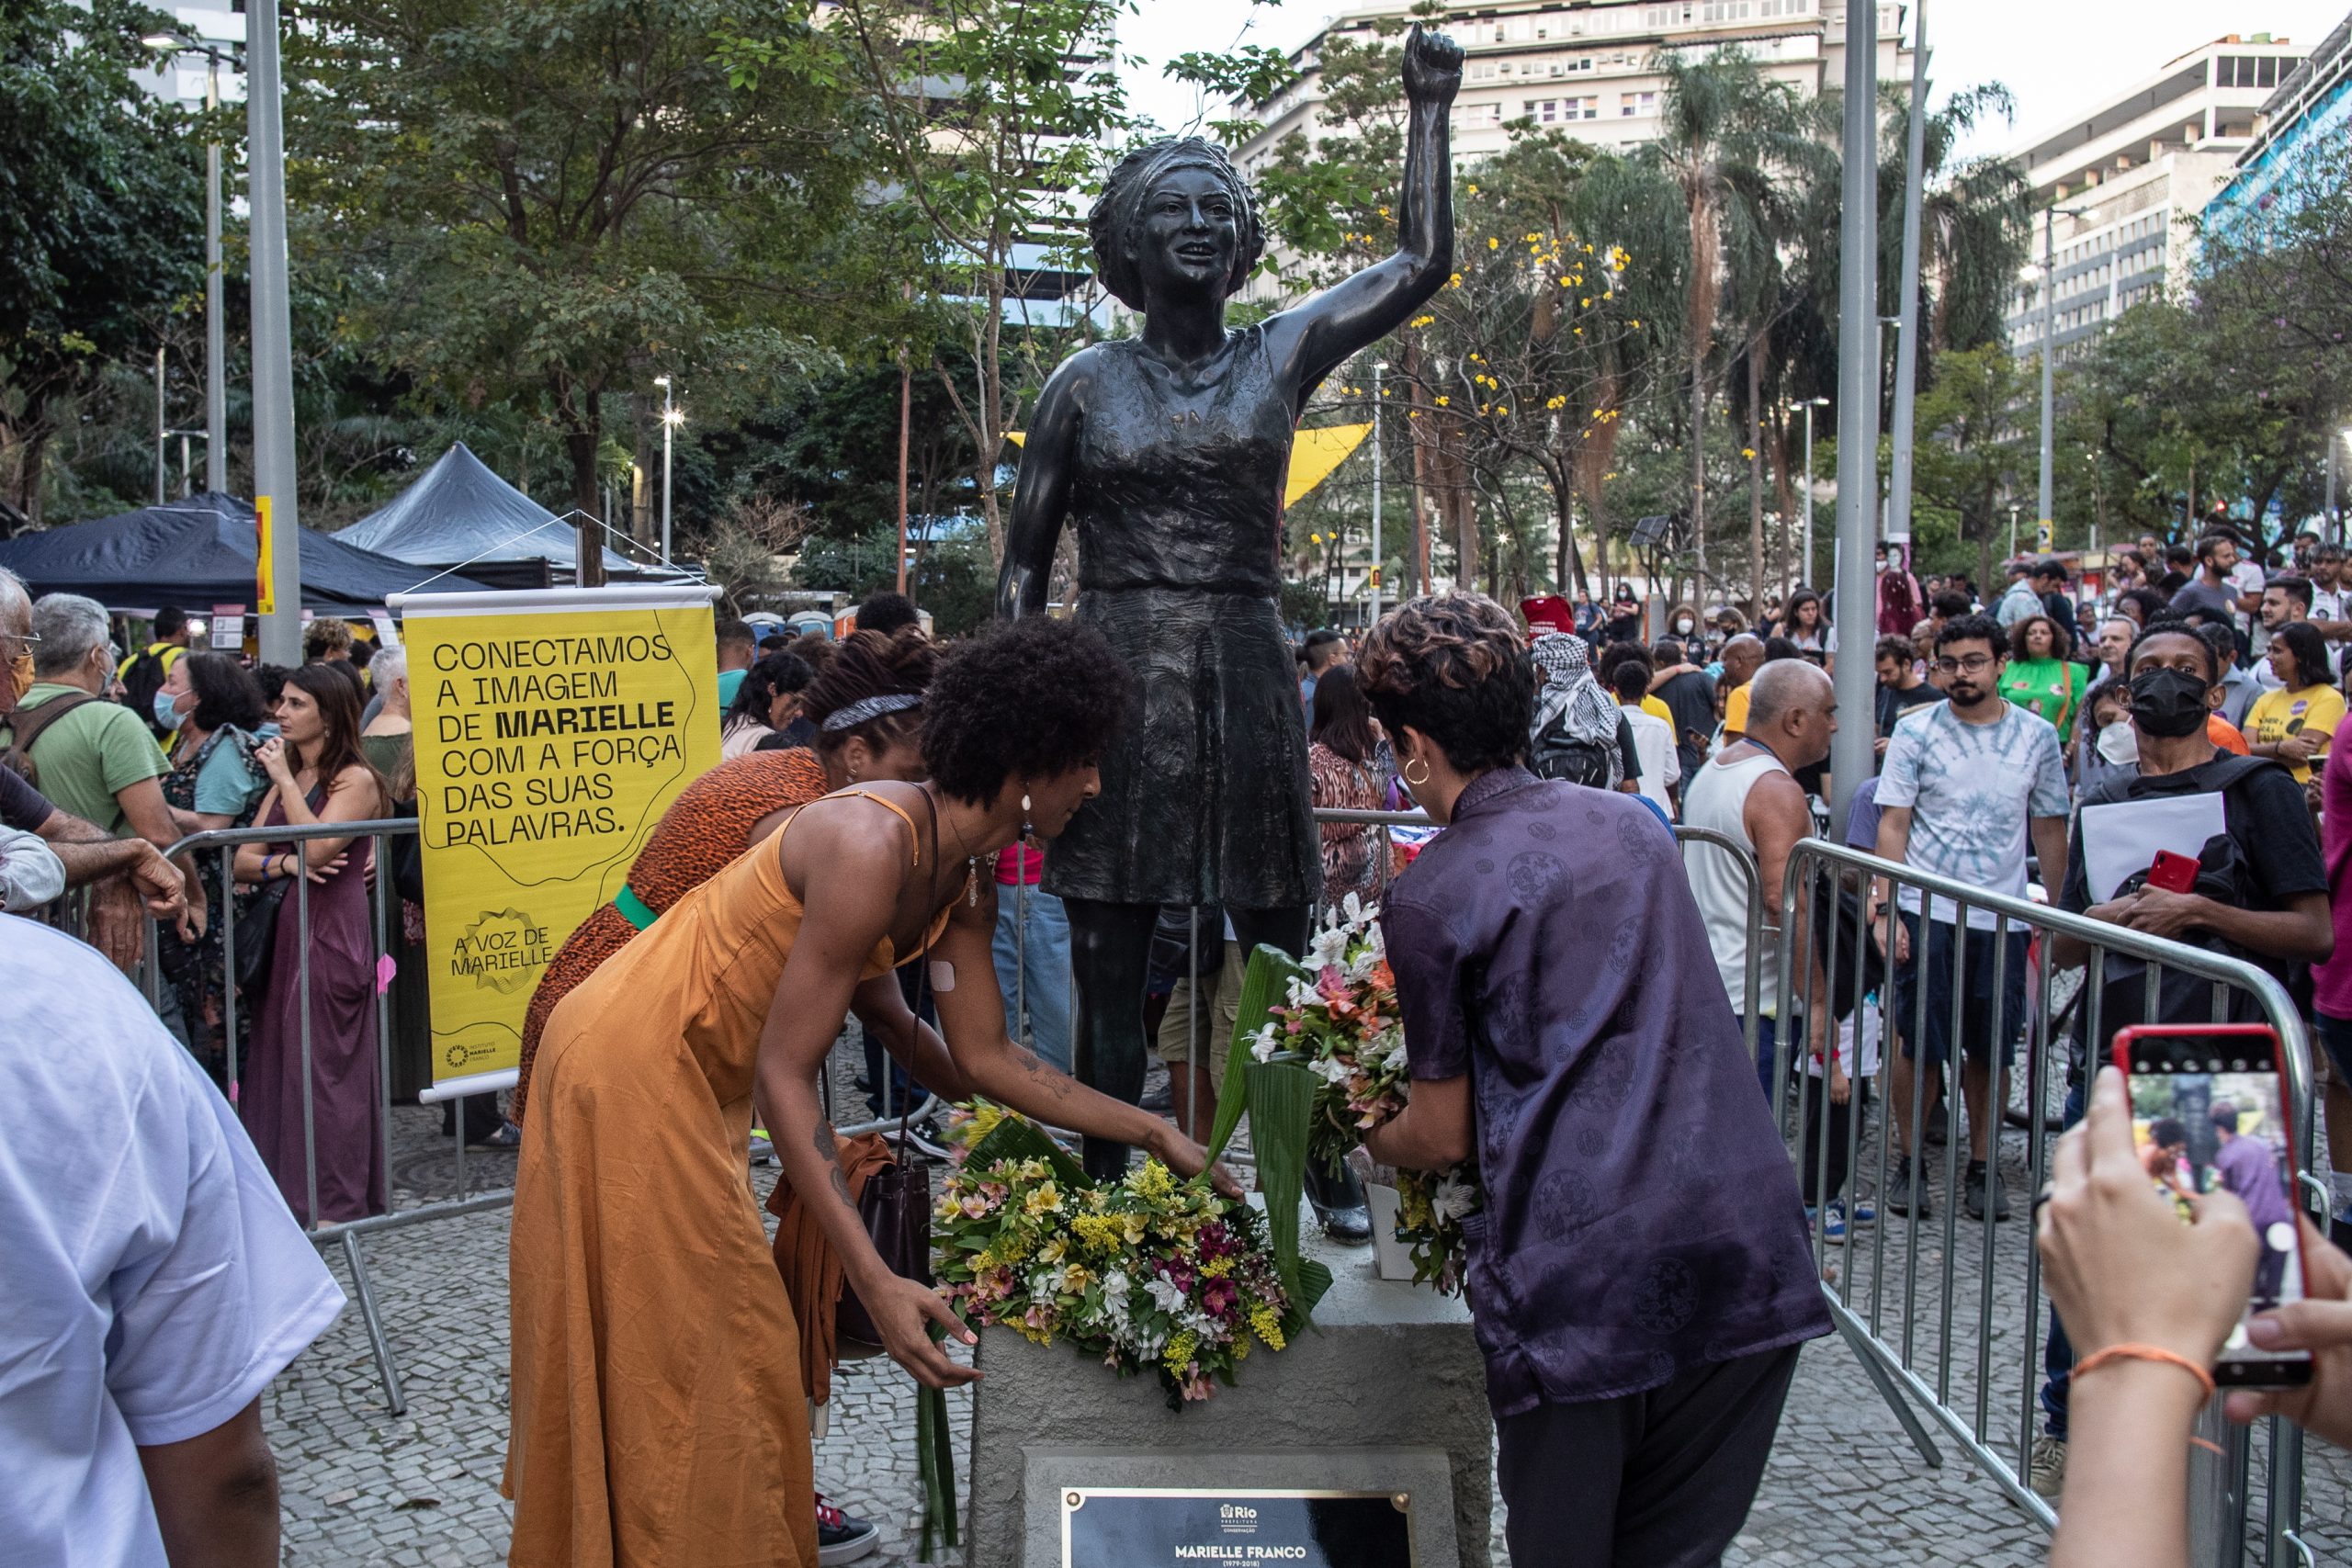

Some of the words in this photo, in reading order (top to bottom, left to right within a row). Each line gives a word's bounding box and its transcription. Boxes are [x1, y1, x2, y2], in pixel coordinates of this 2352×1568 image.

[433, 635, 672, 672] CONECTAMOS
[436, 680, 459, 707] A
[474, 671, 617, 705] IMAGEM
[438, 714, 482, 743] DE
[496, 702, 675, 739] MARIELLE
[442, 744, 525, 778] COM
[539, 742, 560, 771] A
[574, 735, 681, 769] FORÇA
[444, 782, 513, 814] DAS
[526, 773, 614, 805] SUAS
[447, 807, 626, 846] PALAVRAS.
[454, 938, 469, 955] A
[474, 931, 516, 952] VOZ
[524, 927, 548, 945] DE
[450, 947, 553, 976] MARIELLE
[469, 1047, 496, 1055] MARIELLE
[1236, 1506, 1257, 1518] Rio
[1175, 1546, 1242, 1558] MARIELLE
[1248, 1546, 1306, 1558] FRANCO
